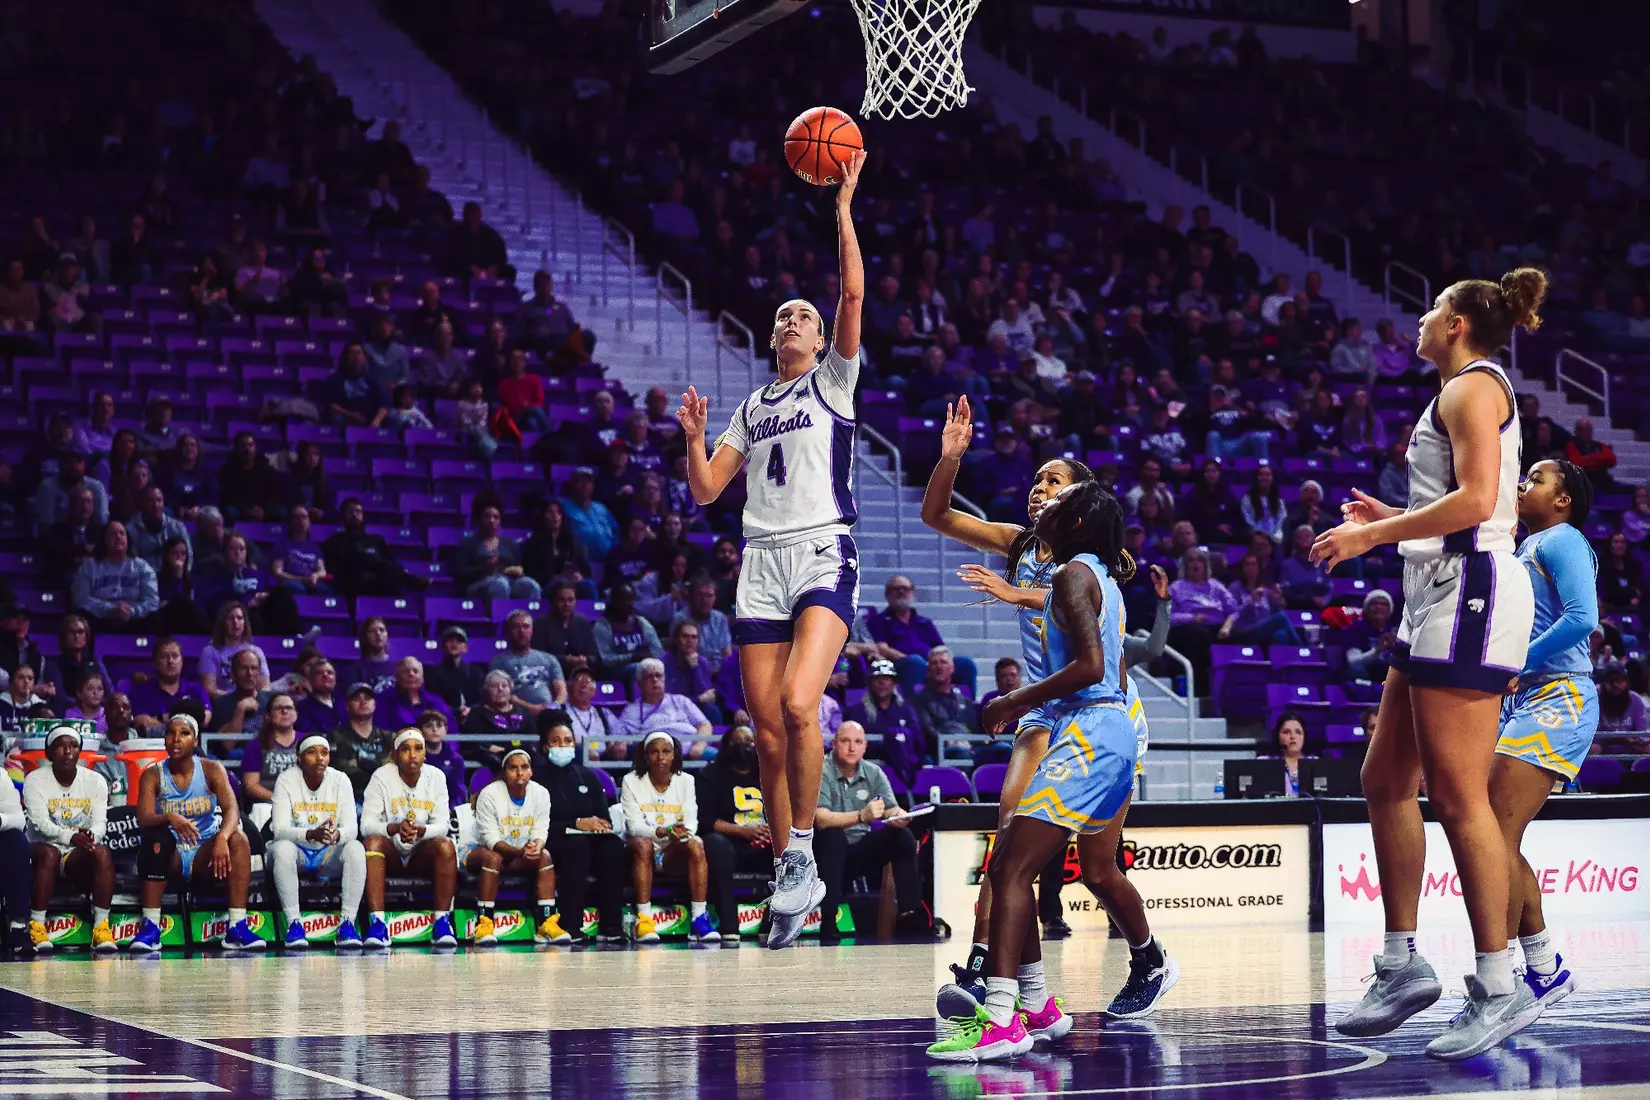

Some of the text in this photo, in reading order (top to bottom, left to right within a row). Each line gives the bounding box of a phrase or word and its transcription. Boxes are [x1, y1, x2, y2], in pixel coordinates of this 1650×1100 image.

[747, 408, 814, 445] Wildcats
[767, 442, 787, 487] 4
[1068, 900, 1090, 912] WE
[1143, 895, 1284, 910] OFESSIONAL GRADE
[389, 913, 434, 936] IBMAN
[653, 908, 682, 923] MAN
